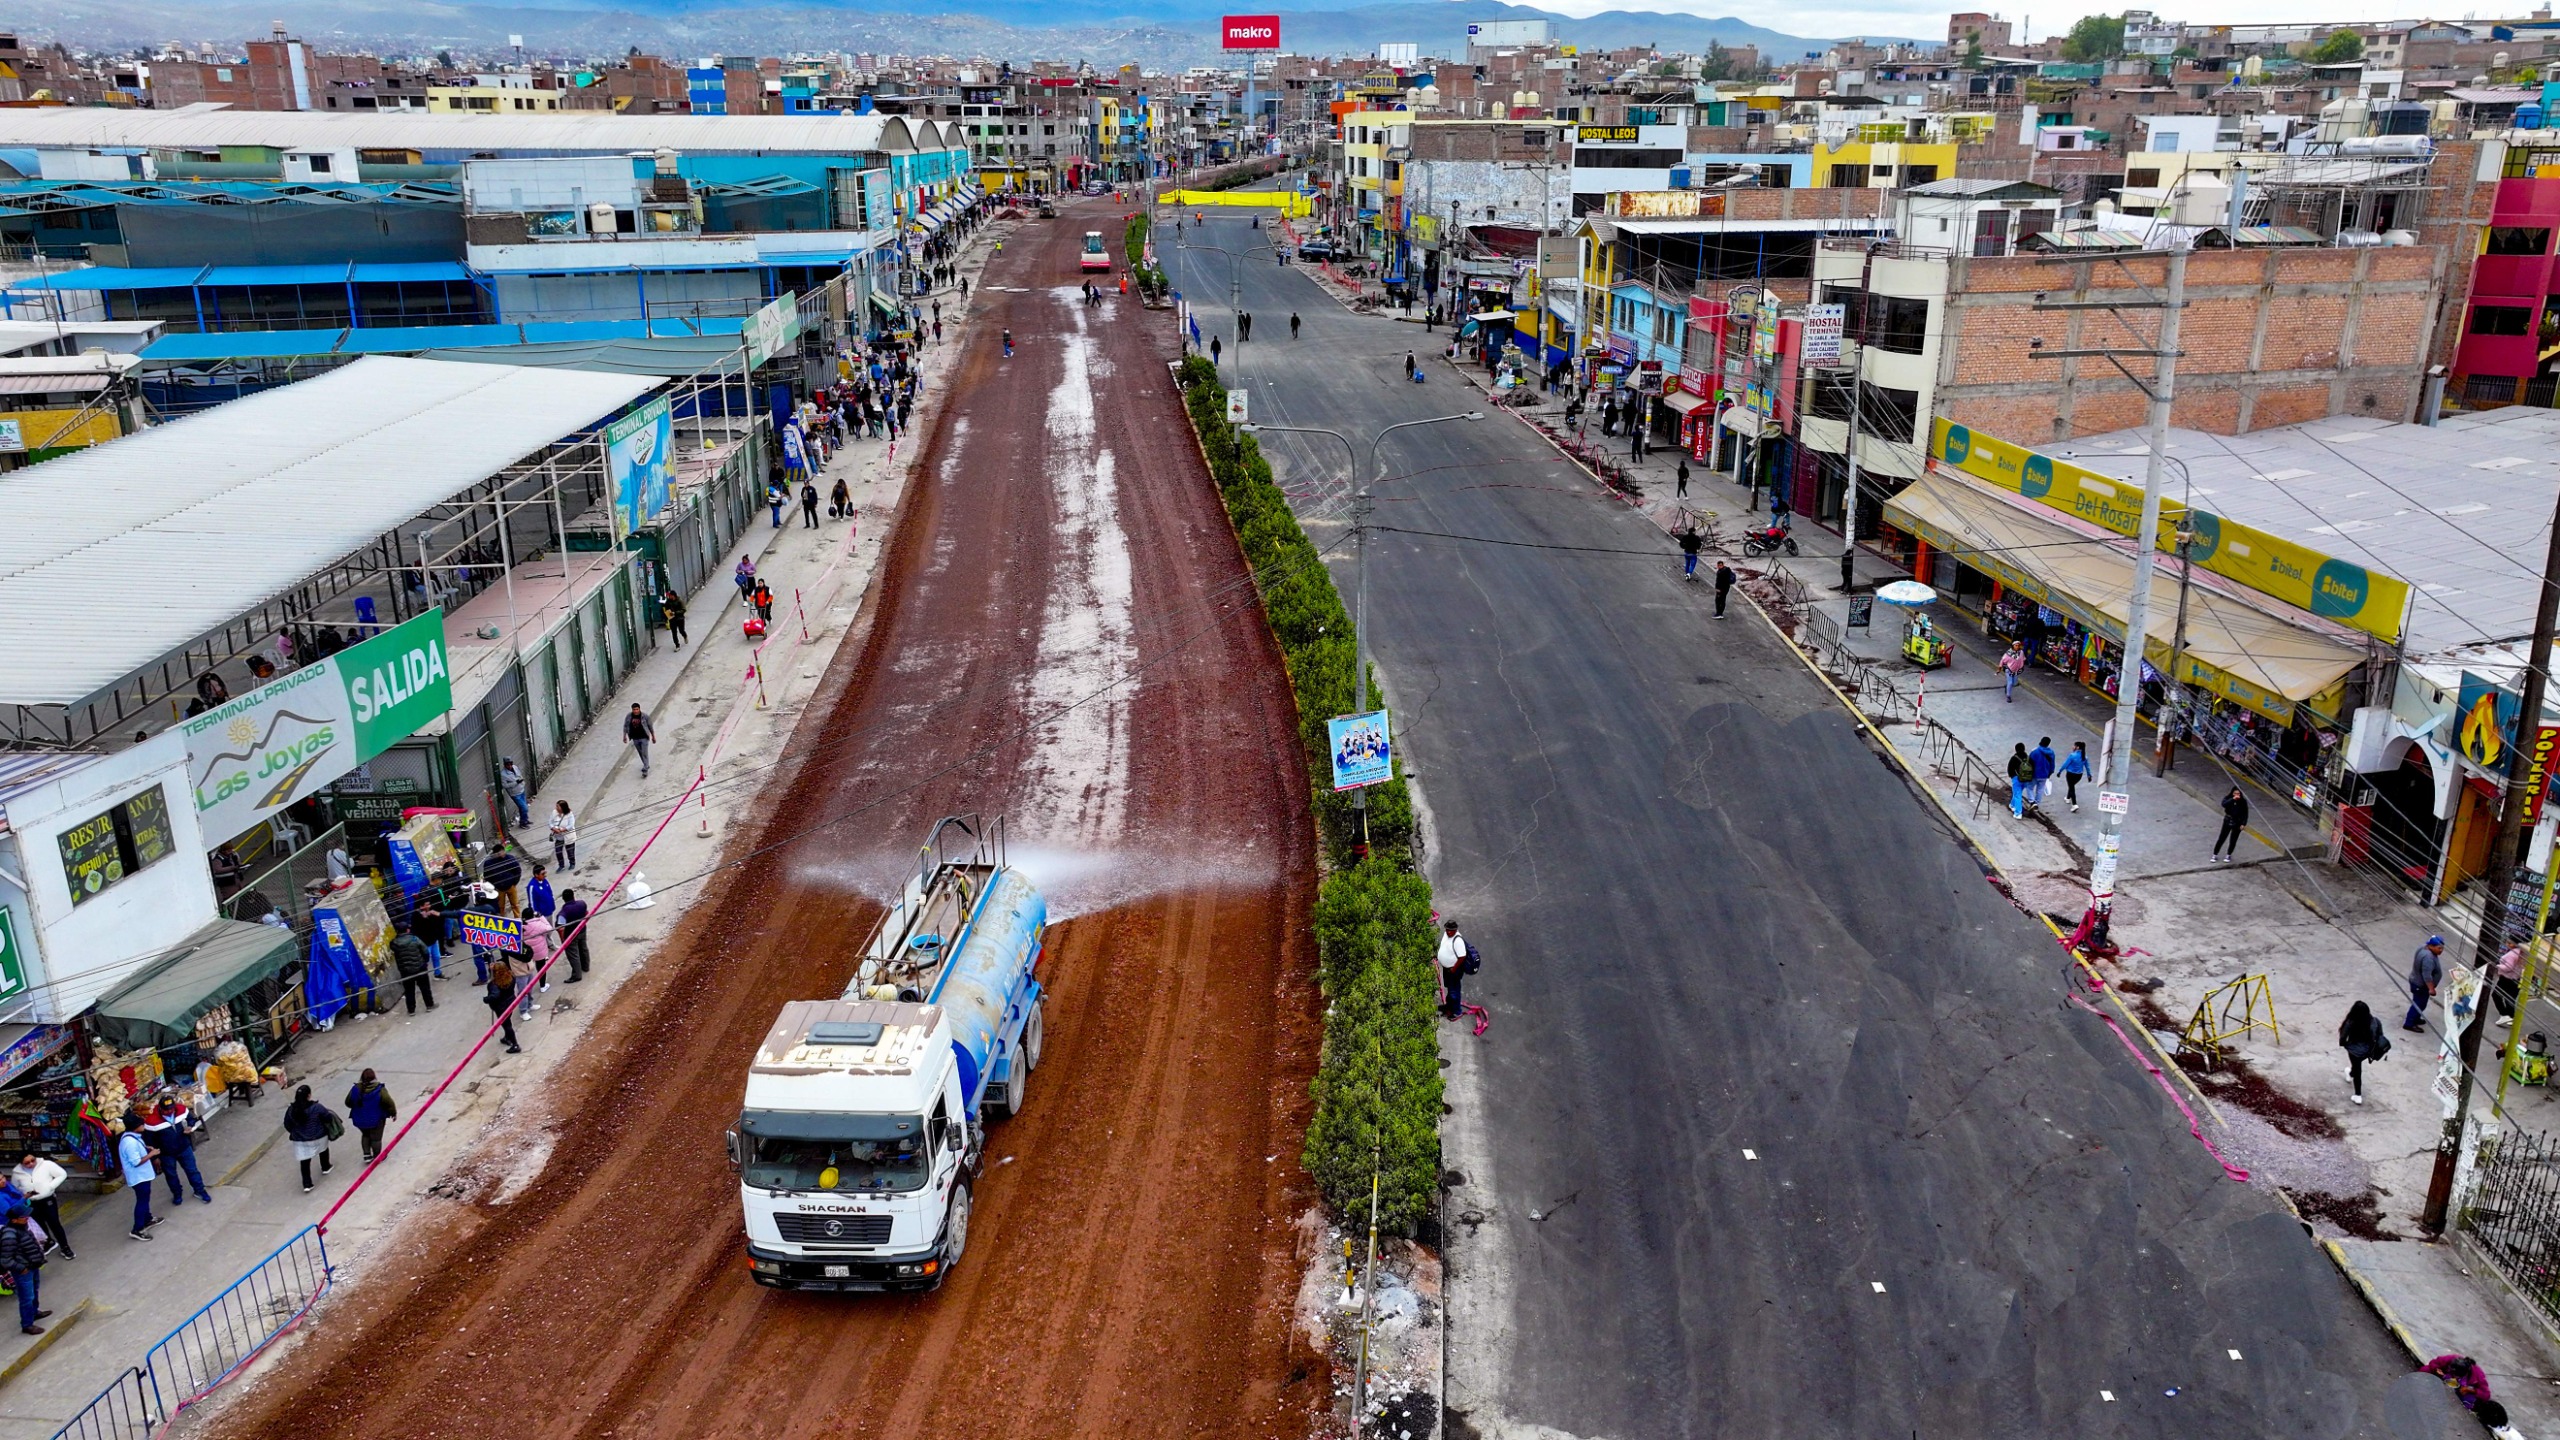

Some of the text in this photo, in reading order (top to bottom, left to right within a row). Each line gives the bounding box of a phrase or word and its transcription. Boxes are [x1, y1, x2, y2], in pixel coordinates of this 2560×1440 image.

[1229, 25, 1272, 38] makro
[1365, 76, 1396, 87] HOSTAL
[1580, 127, 1636, 139] HOSTAL LEOS
[1809, 317, 1842, 327] HOSTAL
[1680, 366, 1702, 384] BOTICA
[1746, 389, 1771, 412] DENAL
[611, 398, 667, 443] TERMINAL PRIVADO
[1952, 438, 1966, 452] bitel
[2001, 459, 2016, 472] bitel
[2031, 469, 2047, 486] bitel
[2116, 489, 2144, 510] Virgen
[2075, 492, 2142, 533] Del Rosari
[2279, 562, 2303, 580] bitel
[2330, 578, 2358, 603] bitel
[352, 639, 446, 723] SALIDA
[182, 663, 326, 737] TERMINAL PRIVADO
[195, 726, 334, 812] Las Joyas
[2523, 729, 2557, 816] POLLERIA
[357, 799, 400, 809] SALIDA
[463, 913, 519, 935] CHALA
[463, 928, 520, 952] YAUCA
[798, 1204, 867, 1213] SHACMAN
